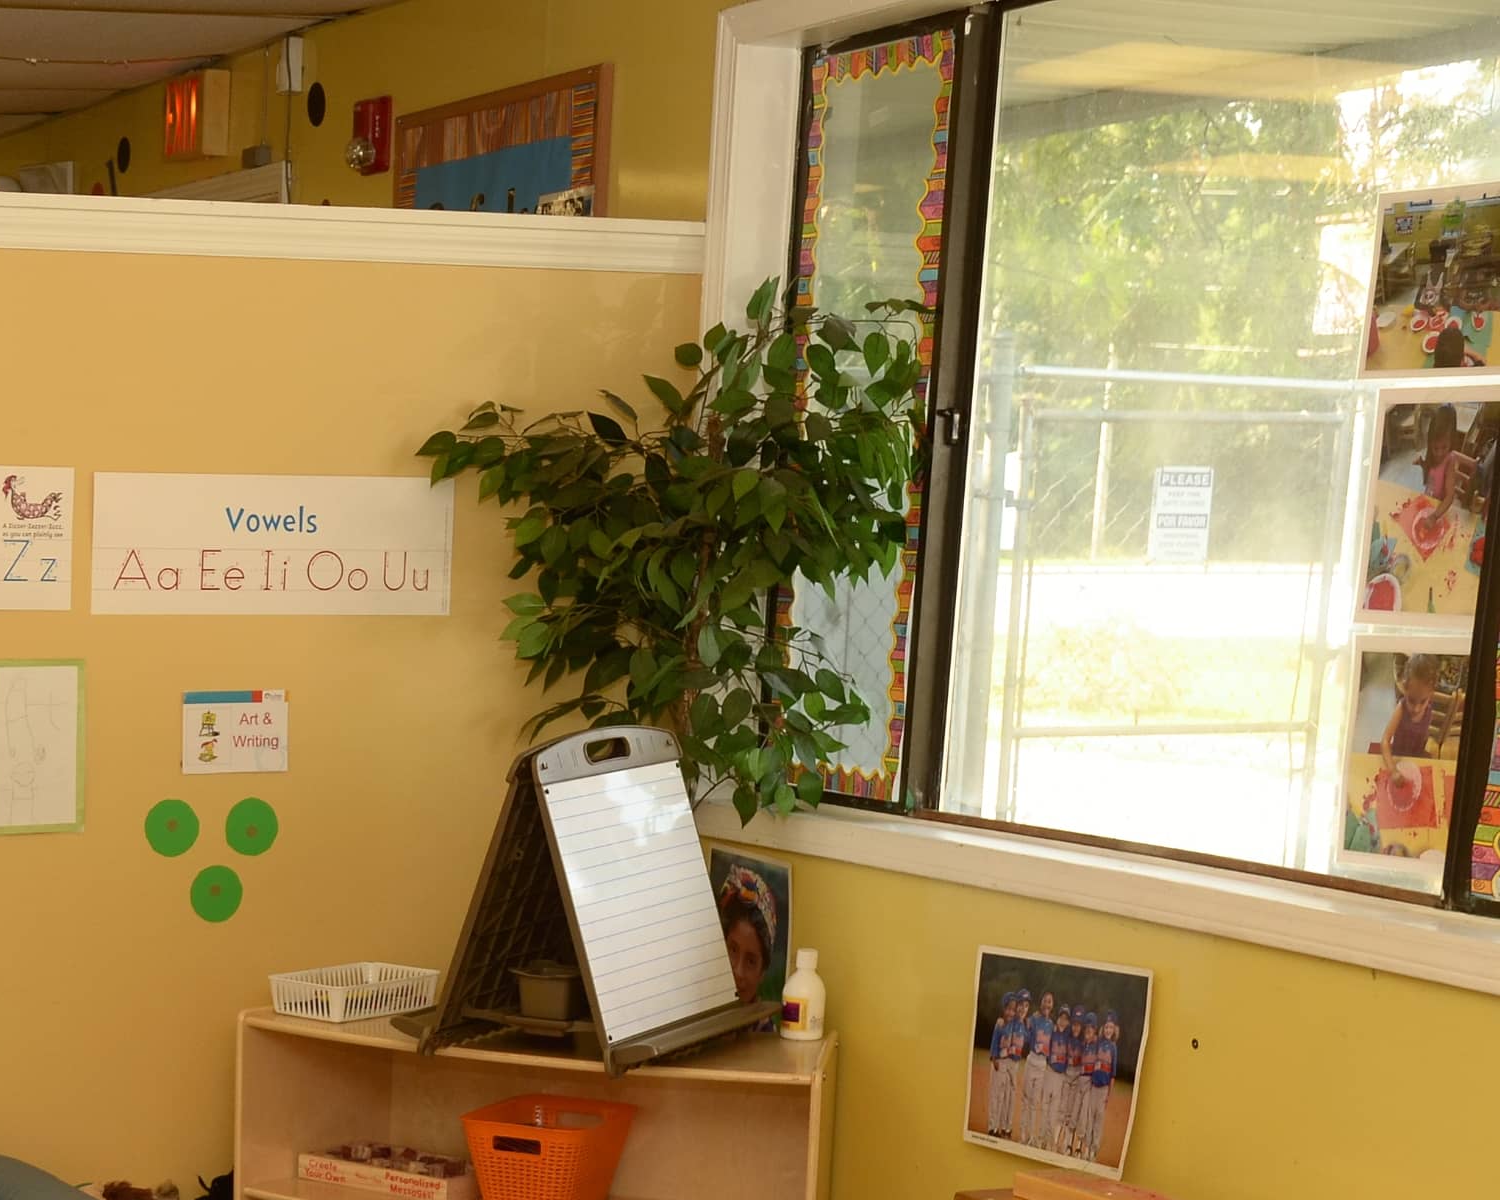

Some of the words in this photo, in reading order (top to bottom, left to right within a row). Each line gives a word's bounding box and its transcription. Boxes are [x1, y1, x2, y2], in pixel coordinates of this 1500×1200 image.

[1161, 472, 1211, 486] PLEASE
[225, 505, 318, 534] Vowels
[3, 539, 57, 582] Zz
[113, 549, 180, 591] Aa
[200, 549, 245, 591] Ee
[262, 549, 288, 591] Ii
[306, 550, 368, 591] Oo
[383, 551, 429, 591] Uu
[239, 712, 258, 726] Art
[262, 711, 273, 726] &
[232, 735, 279, 750] Writing
[308, 1159, 338, 1172] Create
[304, 1167, 323, 1179] Your
[325, 1172, 346, 1184] Own
[385, 1172, 441, 1190] Personalized
